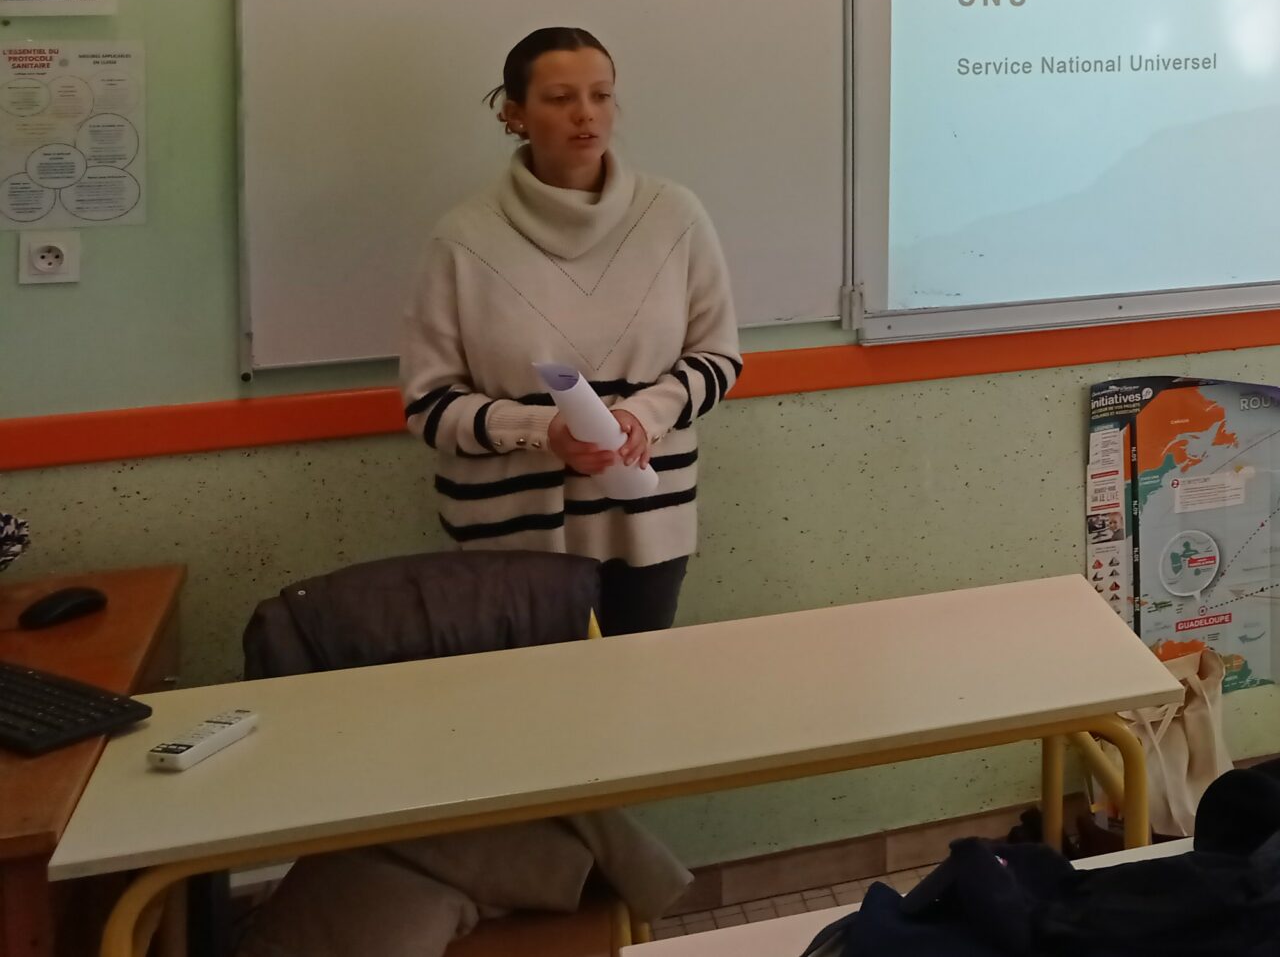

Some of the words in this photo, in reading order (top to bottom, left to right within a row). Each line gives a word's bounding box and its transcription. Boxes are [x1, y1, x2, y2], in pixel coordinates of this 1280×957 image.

[956, 57, 1033, 76] Service
[1041, 54, 1121, 75] National
[1130, 52, 1218, 73] Universel
[1091, 392, 1141, 410] initiatives
[1178, 614, 1231, 630] GUADELOUPE
